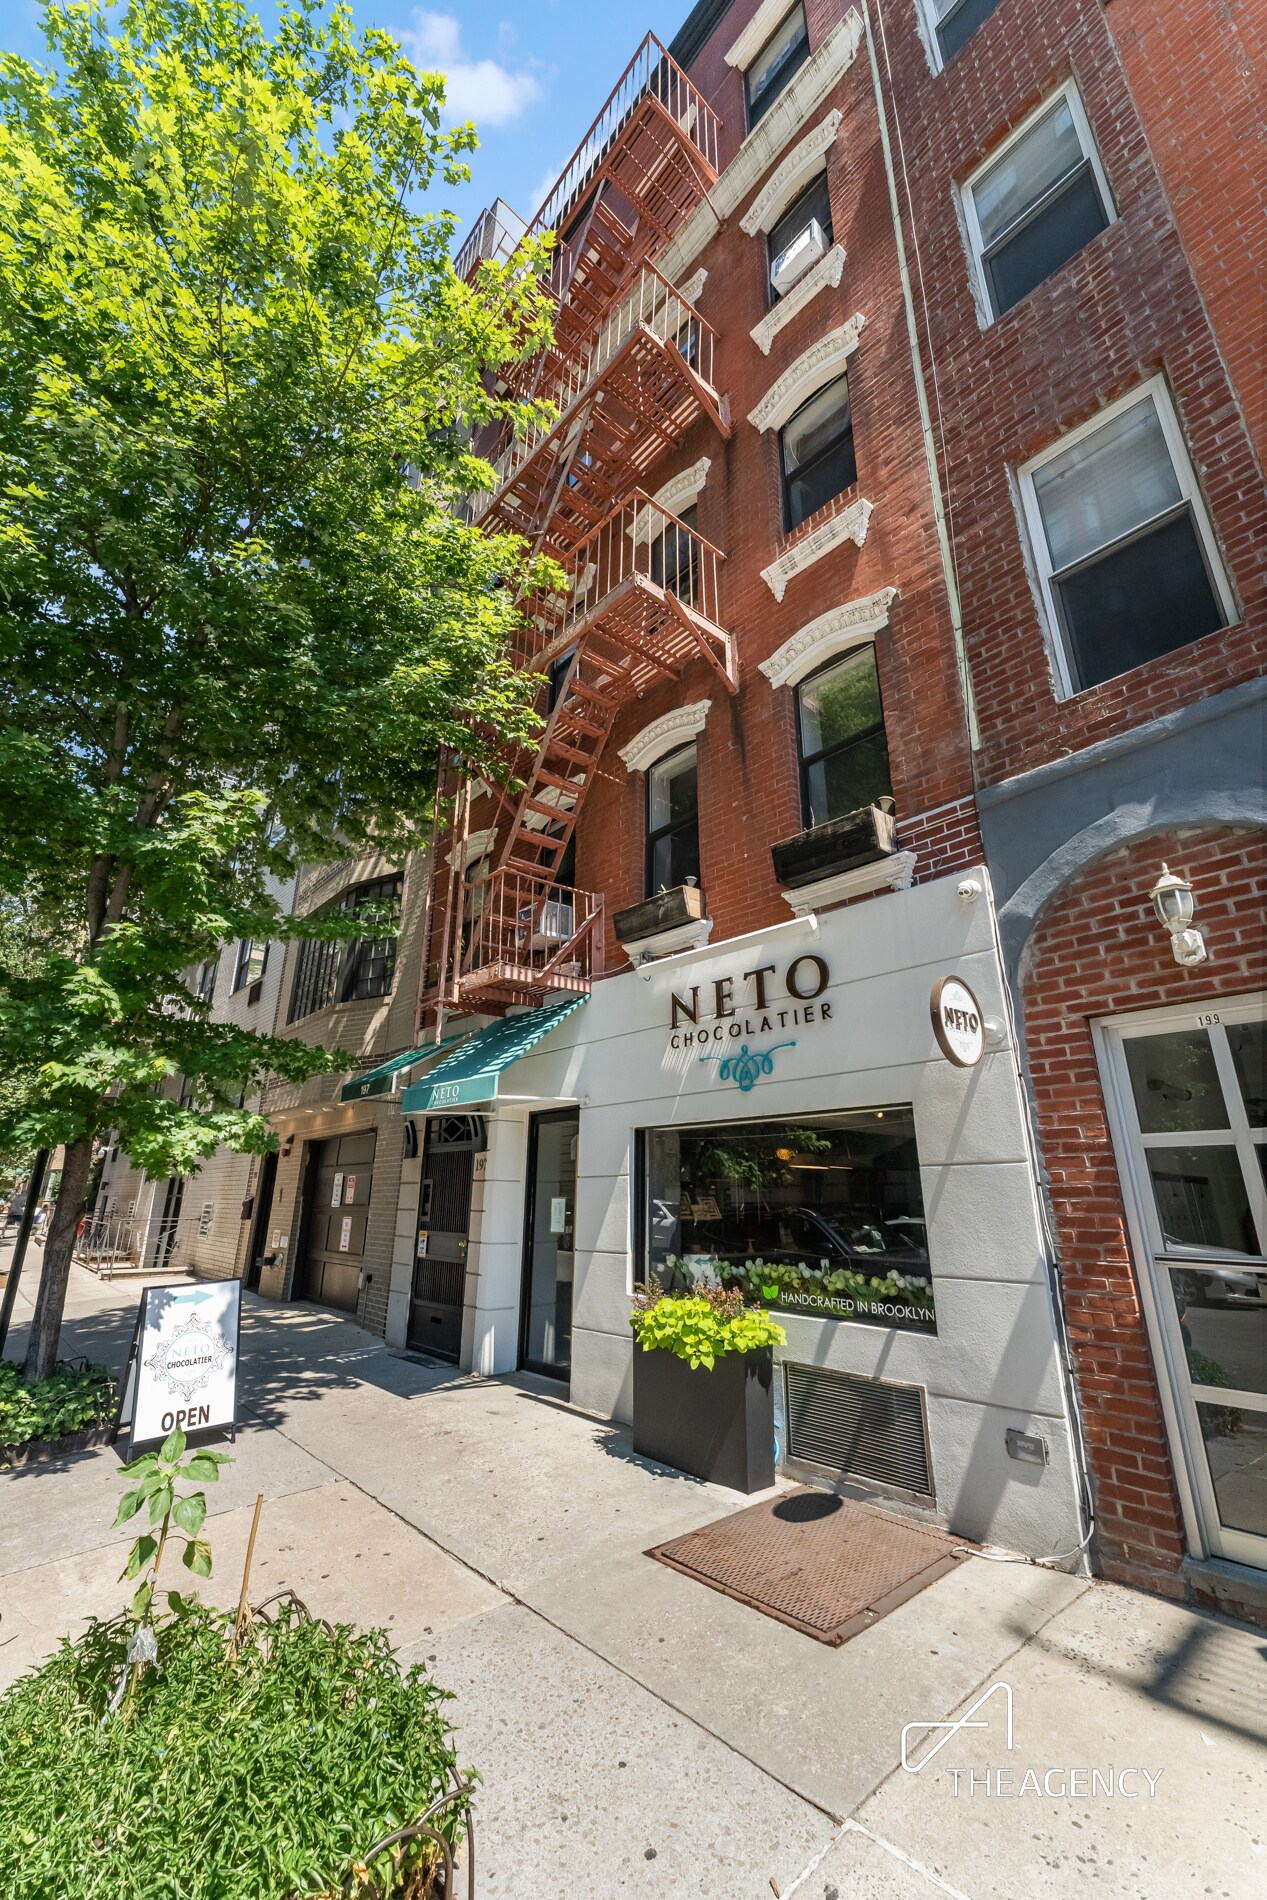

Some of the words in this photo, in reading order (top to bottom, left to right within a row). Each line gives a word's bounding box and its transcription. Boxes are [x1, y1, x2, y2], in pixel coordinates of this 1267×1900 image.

[669, 954, 830, 1030] NETO
[670, 1002, 834, 1050] CHOCOLATIER
[943, 1005, 979, 1033] NETO
[1197, 1013, 1220, 1027] 199
[360, 1083, 371, 1096] 197
[431, 1085, 460, 1100] NETO
[780, 1291, 855, 1311] HANDCRAFTED
[857, 1300, 868, 1313] IN
[871, 1302, 935, 1322] BROOKLYN
[172, 1343, 209, 1358] NETO
[167, 1355, 212, 1369] CHOCOLATIER
[161, 1404, 211, 1432] OPEN
